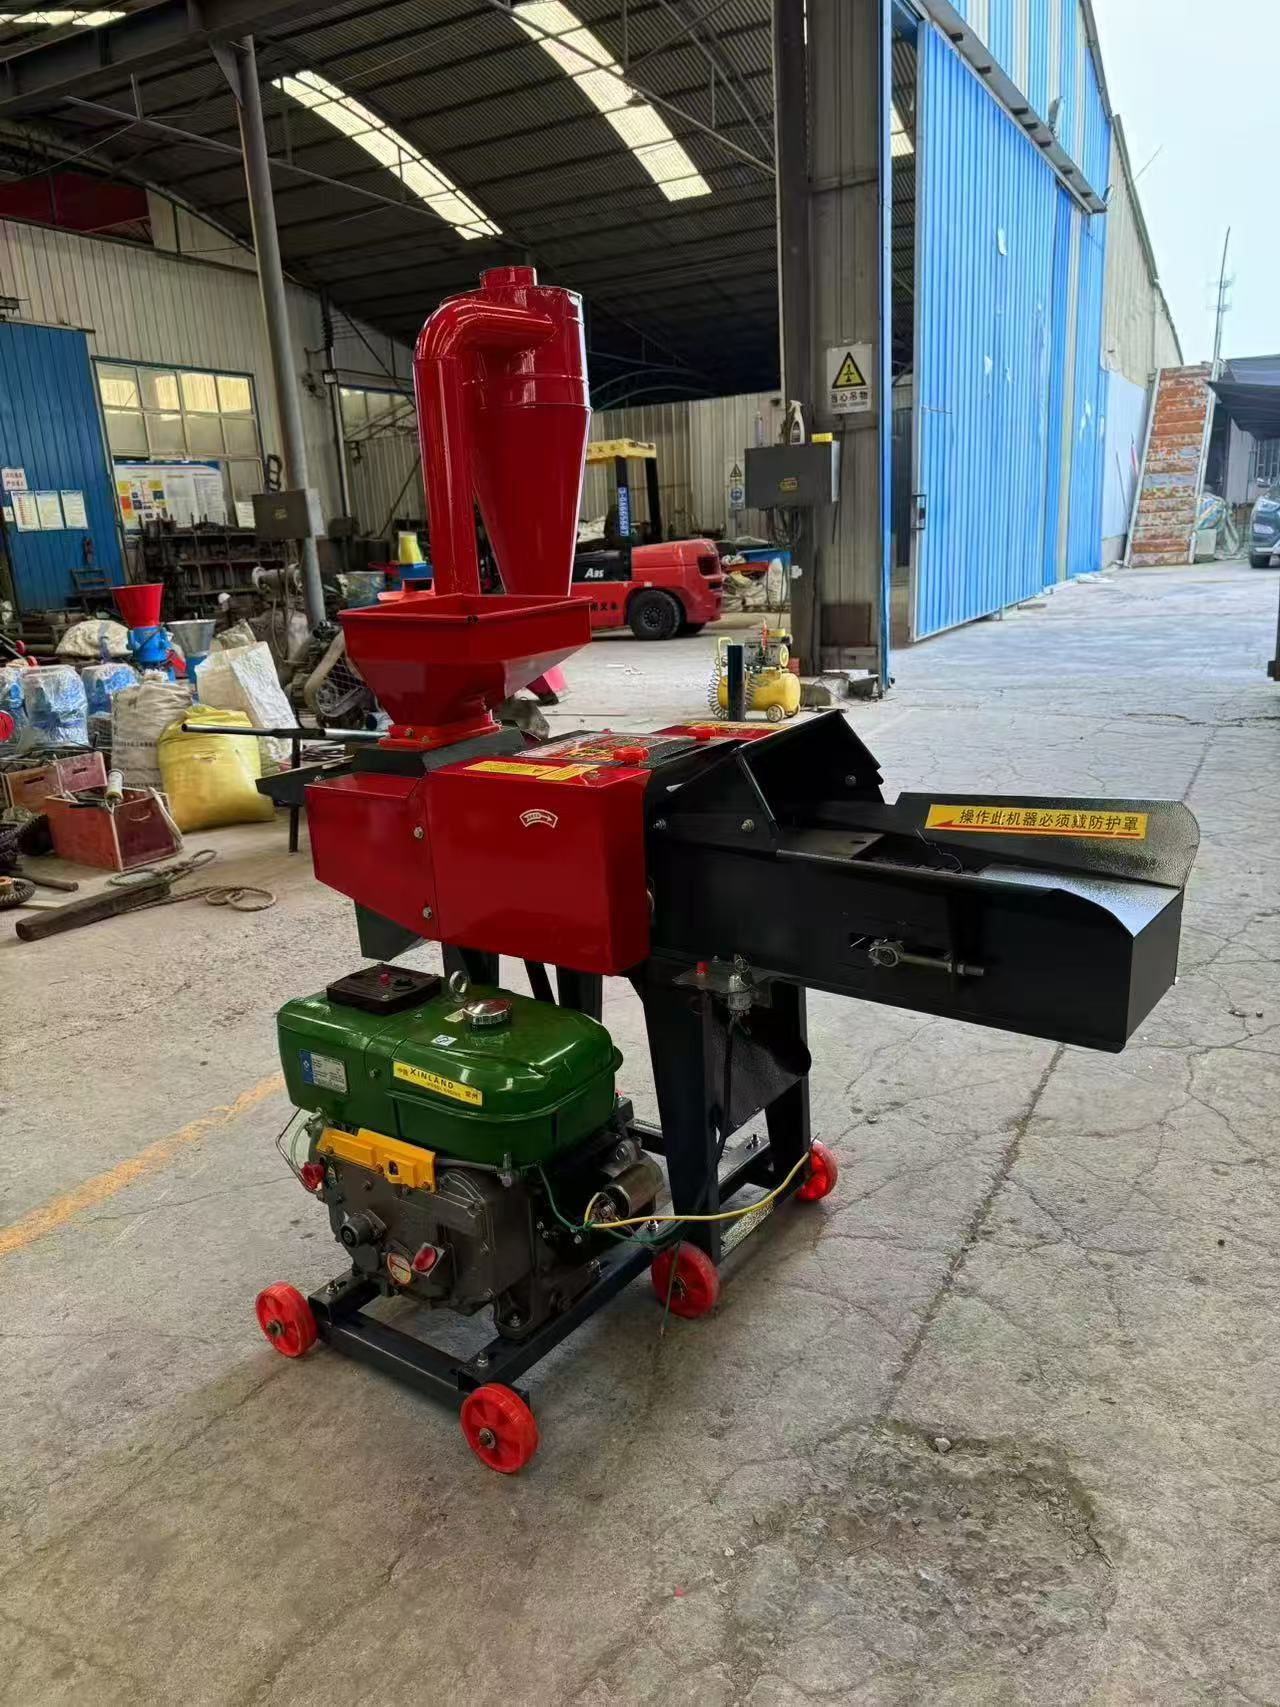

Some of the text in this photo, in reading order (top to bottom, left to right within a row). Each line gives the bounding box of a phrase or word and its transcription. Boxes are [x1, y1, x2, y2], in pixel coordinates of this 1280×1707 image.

[831, 391, 868, 403] 当心吊物
[959, 809, 1138, 831] 操作此机器必须戴防护罩
[409, 1067, 454, 1090] XINLAND
